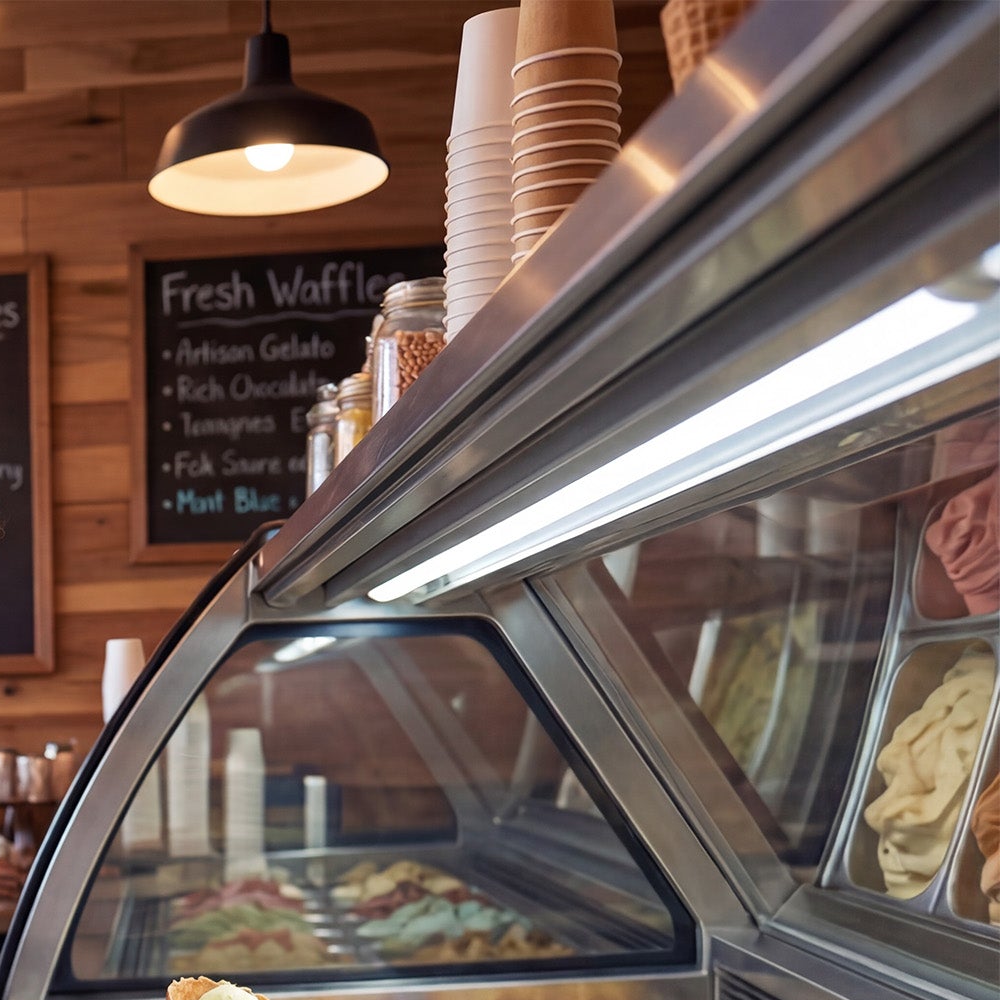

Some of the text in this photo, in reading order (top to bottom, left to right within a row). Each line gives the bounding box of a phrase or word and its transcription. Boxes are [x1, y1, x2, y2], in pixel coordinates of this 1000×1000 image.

[161, 269, 255, 316] Fresh
[259, 333, 336, 362] Gelato
[234, 486, 281, 514] Blue
